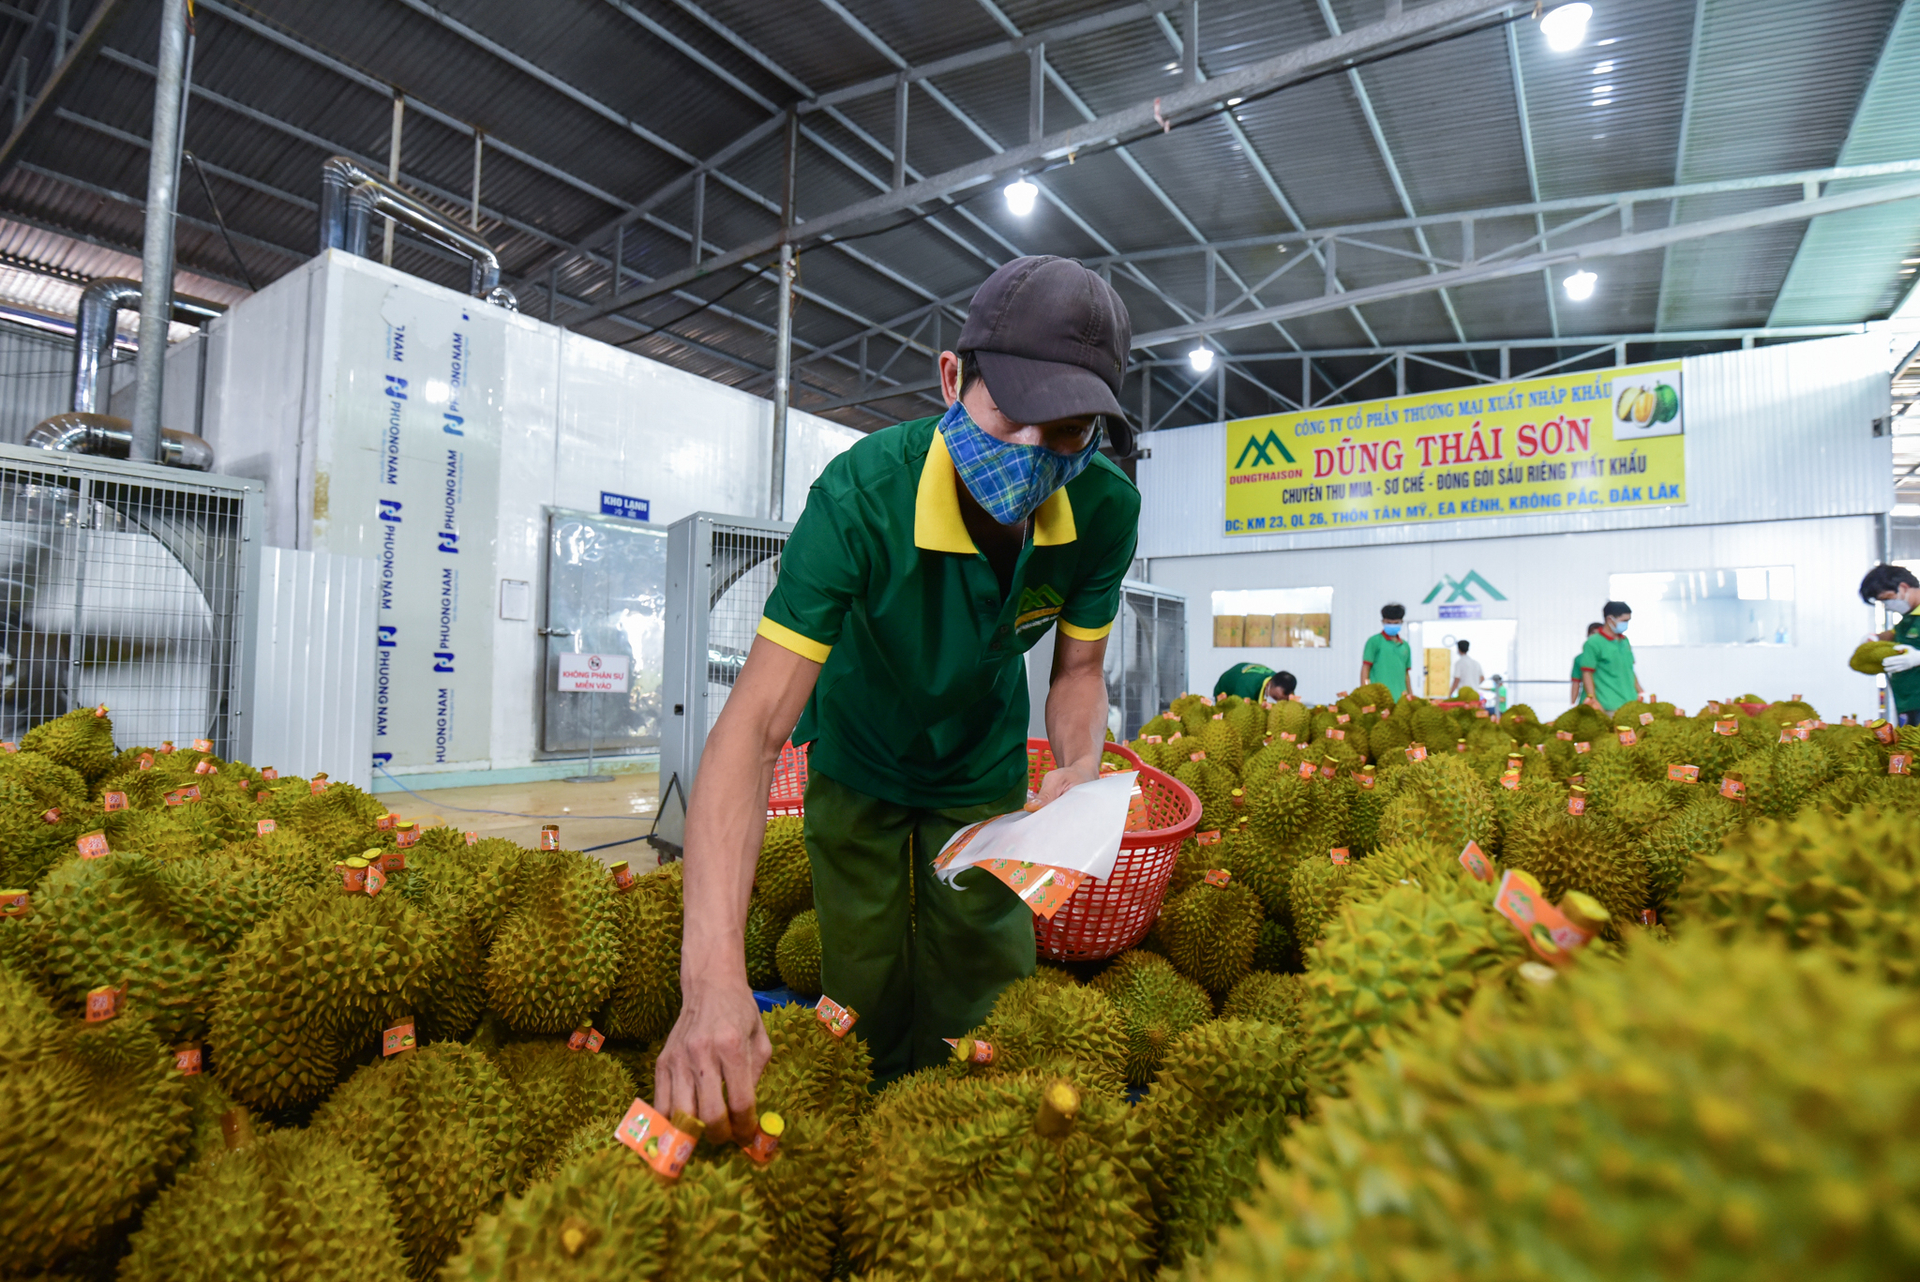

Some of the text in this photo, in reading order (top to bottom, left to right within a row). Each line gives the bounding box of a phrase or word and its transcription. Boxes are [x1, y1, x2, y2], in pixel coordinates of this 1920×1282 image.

[452, 332, 463, 361] NAM
[387, 400, 402, 485] PHUONG NAM
[1294, 418, 1325, 437] CÔNG
[1329, 417, 1344, 432] TY
[1313, 415, 1591, 478] DŨNG THÁI SƠN
[444, 449, 457, 530] PHUONG NAM
[1229, 469, 1303, 485] DUNGTHAISON
[1282, 483, 1322, 504] CHUYÊN
[1326, 484, 1345, 501] THU
[1349, 481, 1373, 498] MUA
[1384, 476, 1399, 495] SƠ
[1403, 470, 1425, 493] CHẾ
[1527, 460, 1567, 482] RIÊNG
[603, 495, 647, 512] KHO LẠNH
[1247, 517, 1265, 530] KM
[1291, 514, 1305, 527] QL
[1332, 507, 1368, 523] THÔN
[1373, 505, 1401, 520] TÂN
[1438, 502, 1456, 515] EA
[1509, 492, 1561, 510] KRÔNG
[381, 525, 396, 609] PHUONG NAM
[439, 568, 452, 649] PHUONG NAM
[376, 651, 390, 736] PHUONG NAM
[563, 670, 590, 678] KHÔNG
[437, 688, 448, 716] NAM
